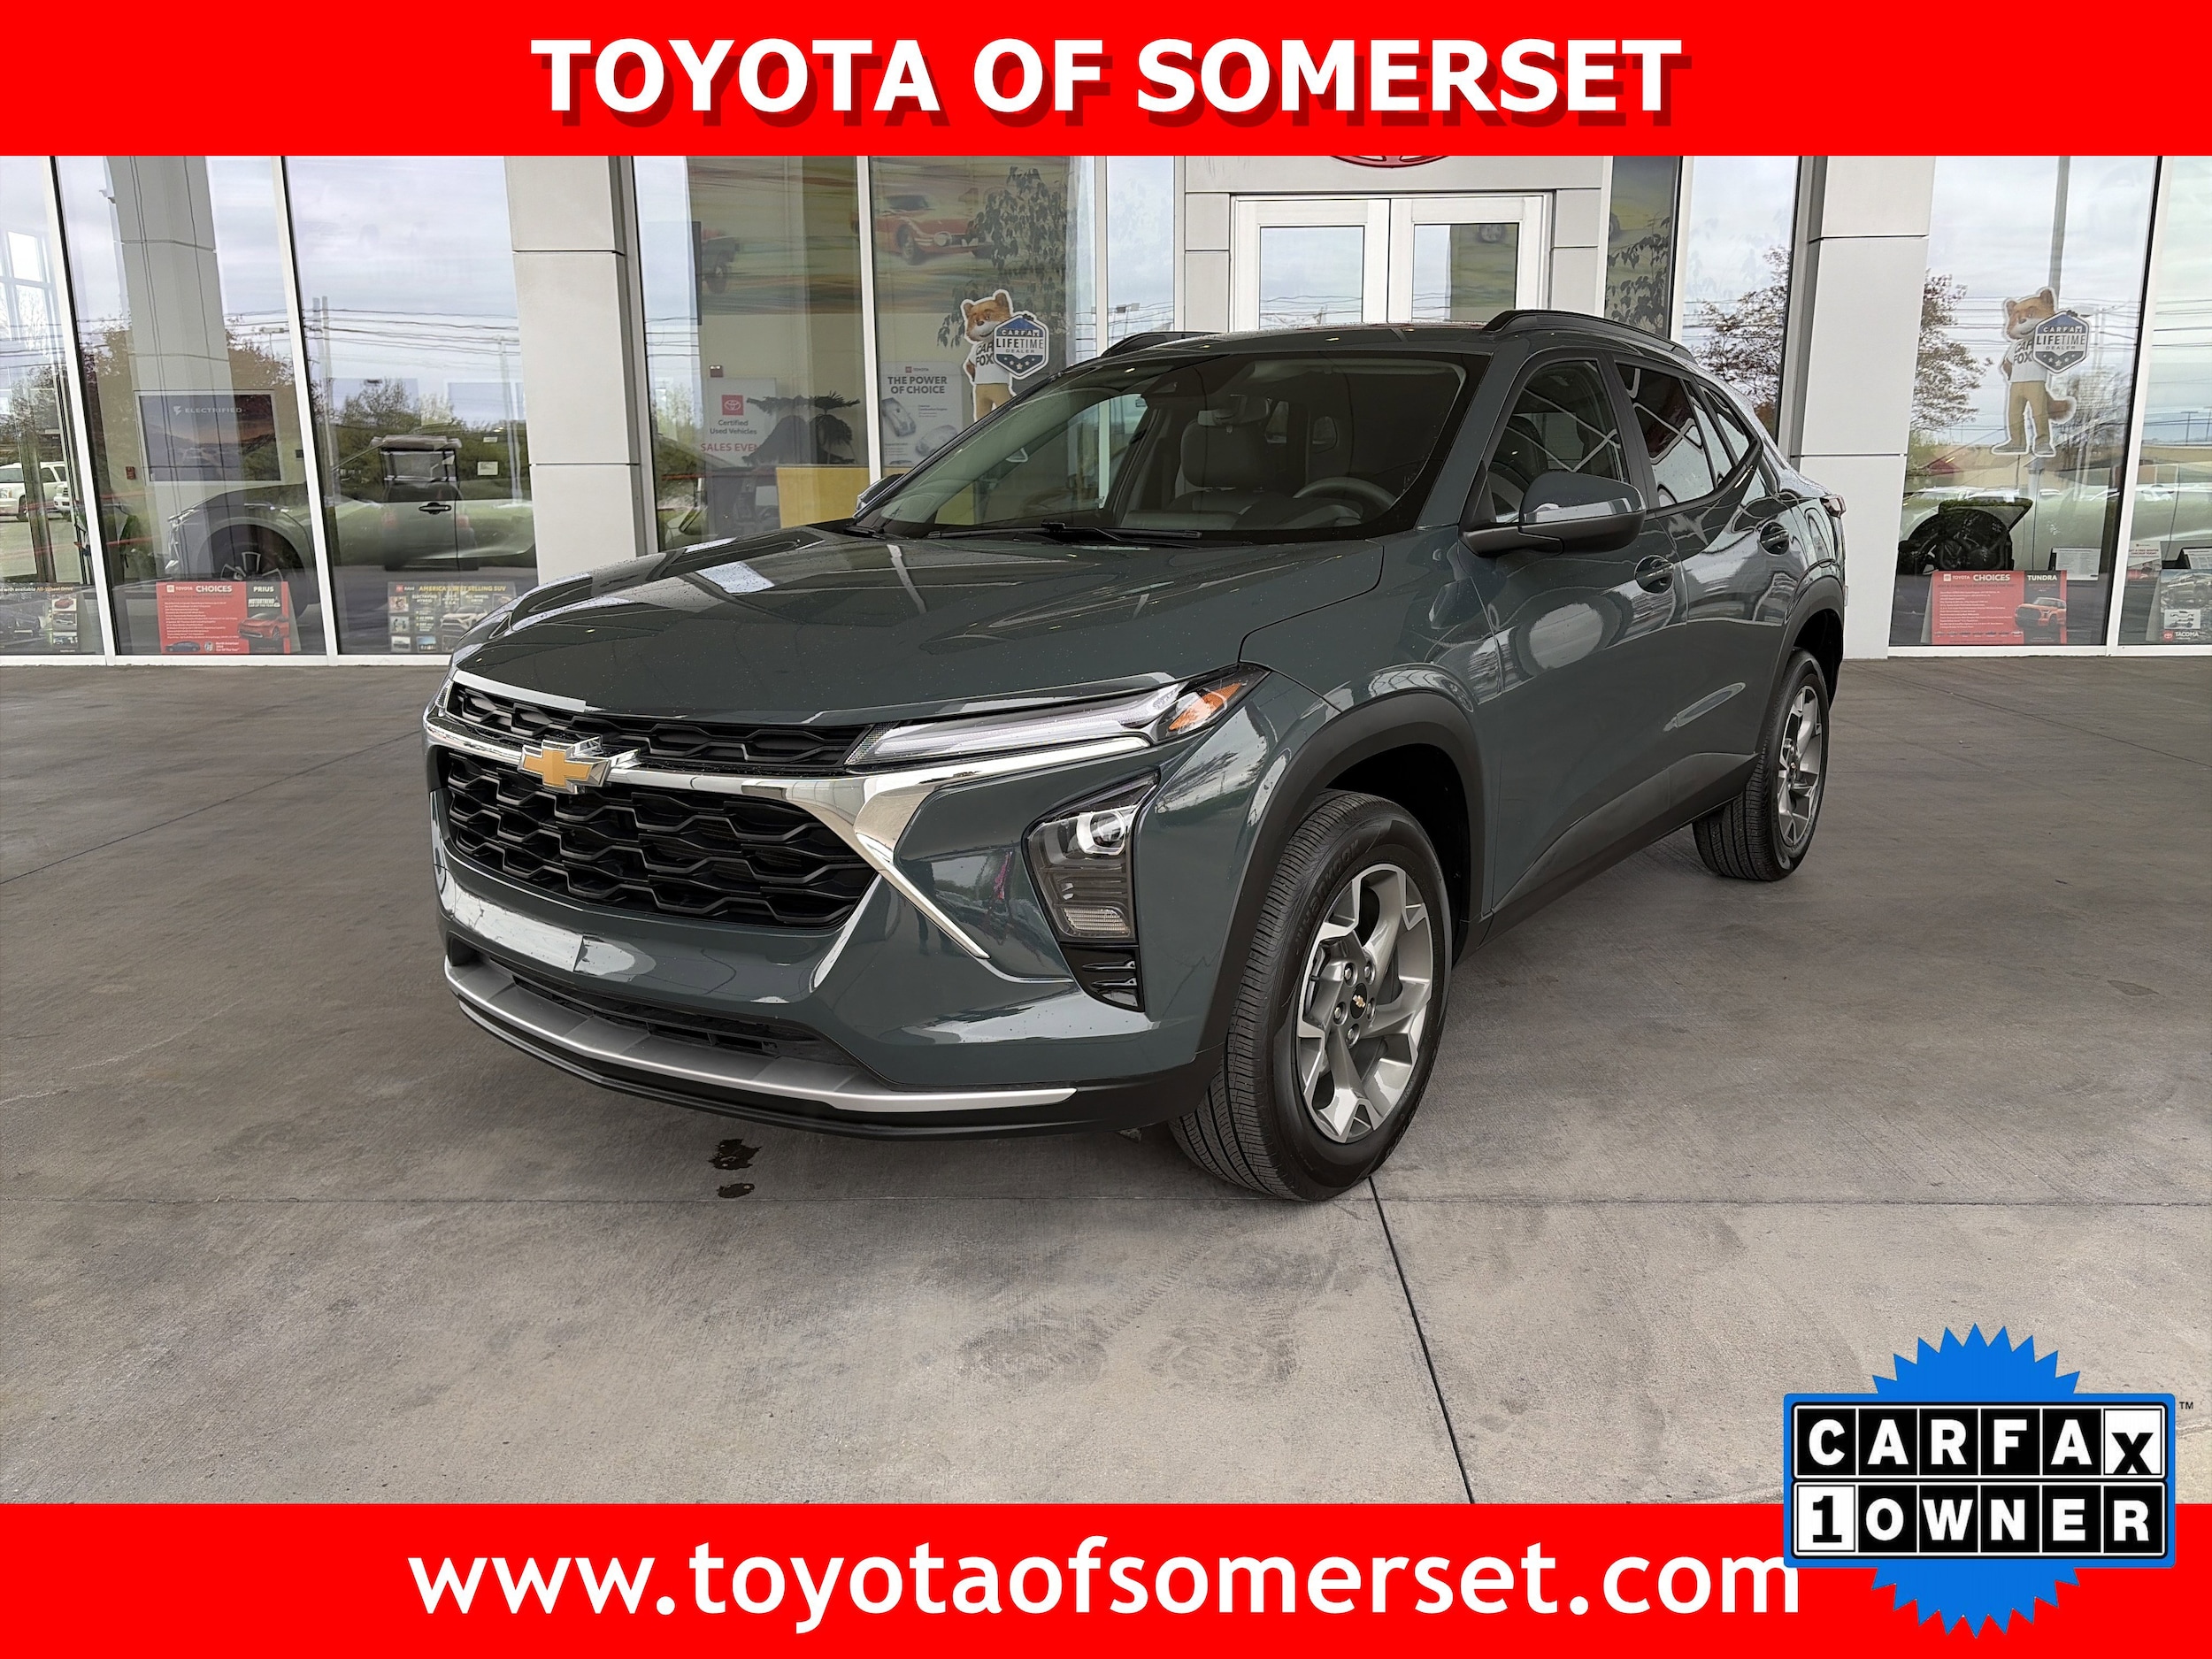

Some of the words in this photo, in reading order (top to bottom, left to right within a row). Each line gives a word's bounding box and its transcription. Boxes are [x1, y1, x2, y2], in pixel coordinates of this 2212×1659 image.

[996, 338, 1044, 349] LIFETIME
[2036, 335, 2085, 345] LIFETIME
[976, 354, 995, 366] FOX
[2013, 352, 2032, 364] FOX
[887, 376, 907, 385] THE
[910, 376, 948, 385] POWER
[890, 386, 904, 395] OF
[906, 386, 945, 395] CHOICE
[700, 443, 733, 452] SALES
